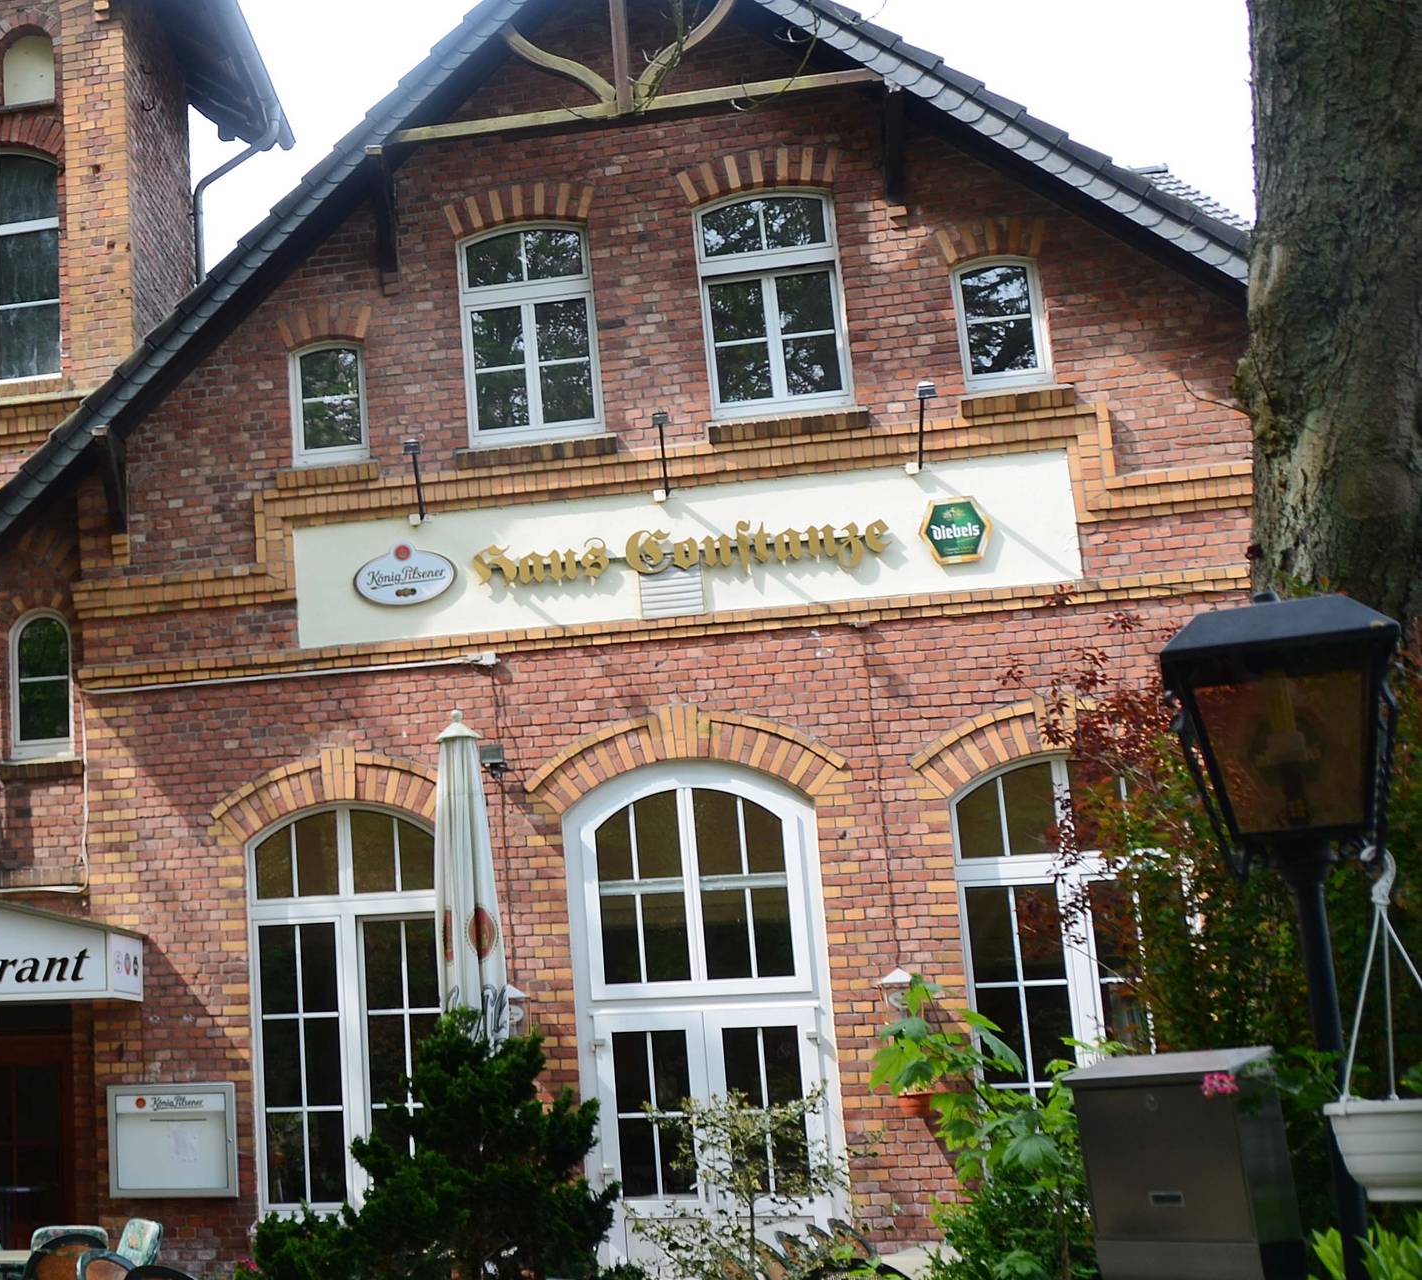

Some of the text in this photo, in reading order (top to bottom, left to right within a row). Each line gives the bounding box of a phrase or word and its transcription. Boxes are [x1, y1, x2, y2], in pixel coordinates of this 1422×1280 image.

[366, 565, 445, 587] König Pilsener
[473, 537, 610, 586] Haus
